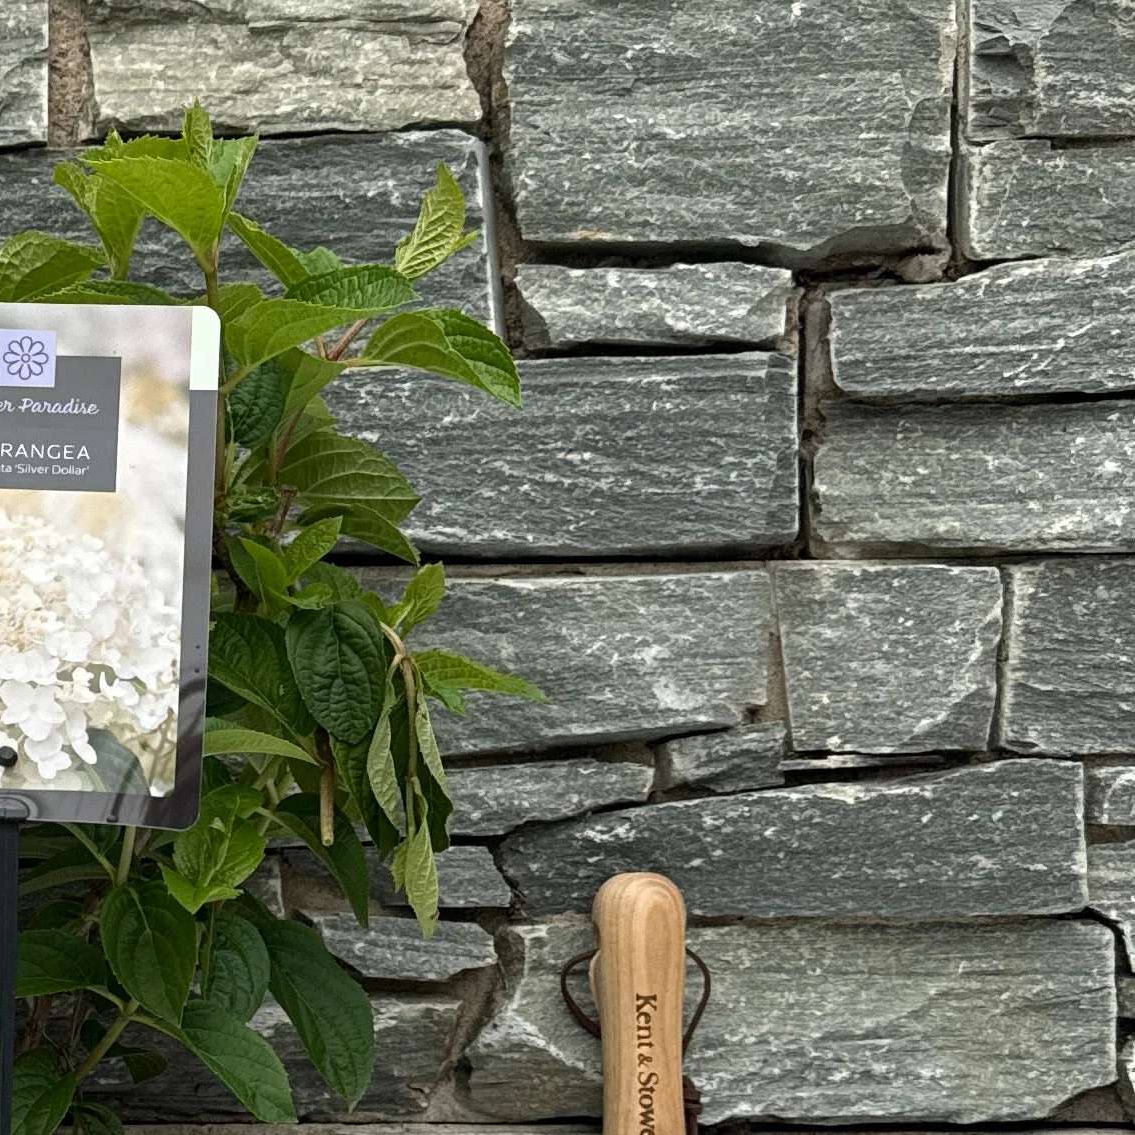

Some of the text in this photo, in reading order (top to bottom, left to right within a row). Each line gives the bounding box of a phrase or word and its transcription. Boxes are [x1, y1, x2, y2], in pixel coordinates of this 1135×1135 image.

[18, 397, 99, 415] Paradise
[15, 463, 49, 474] 'Silver
[51, 464, 90, 475] Dollar'
[636, 993, 657, 1050] Kent
[638, 1053, 652, 1068] &
